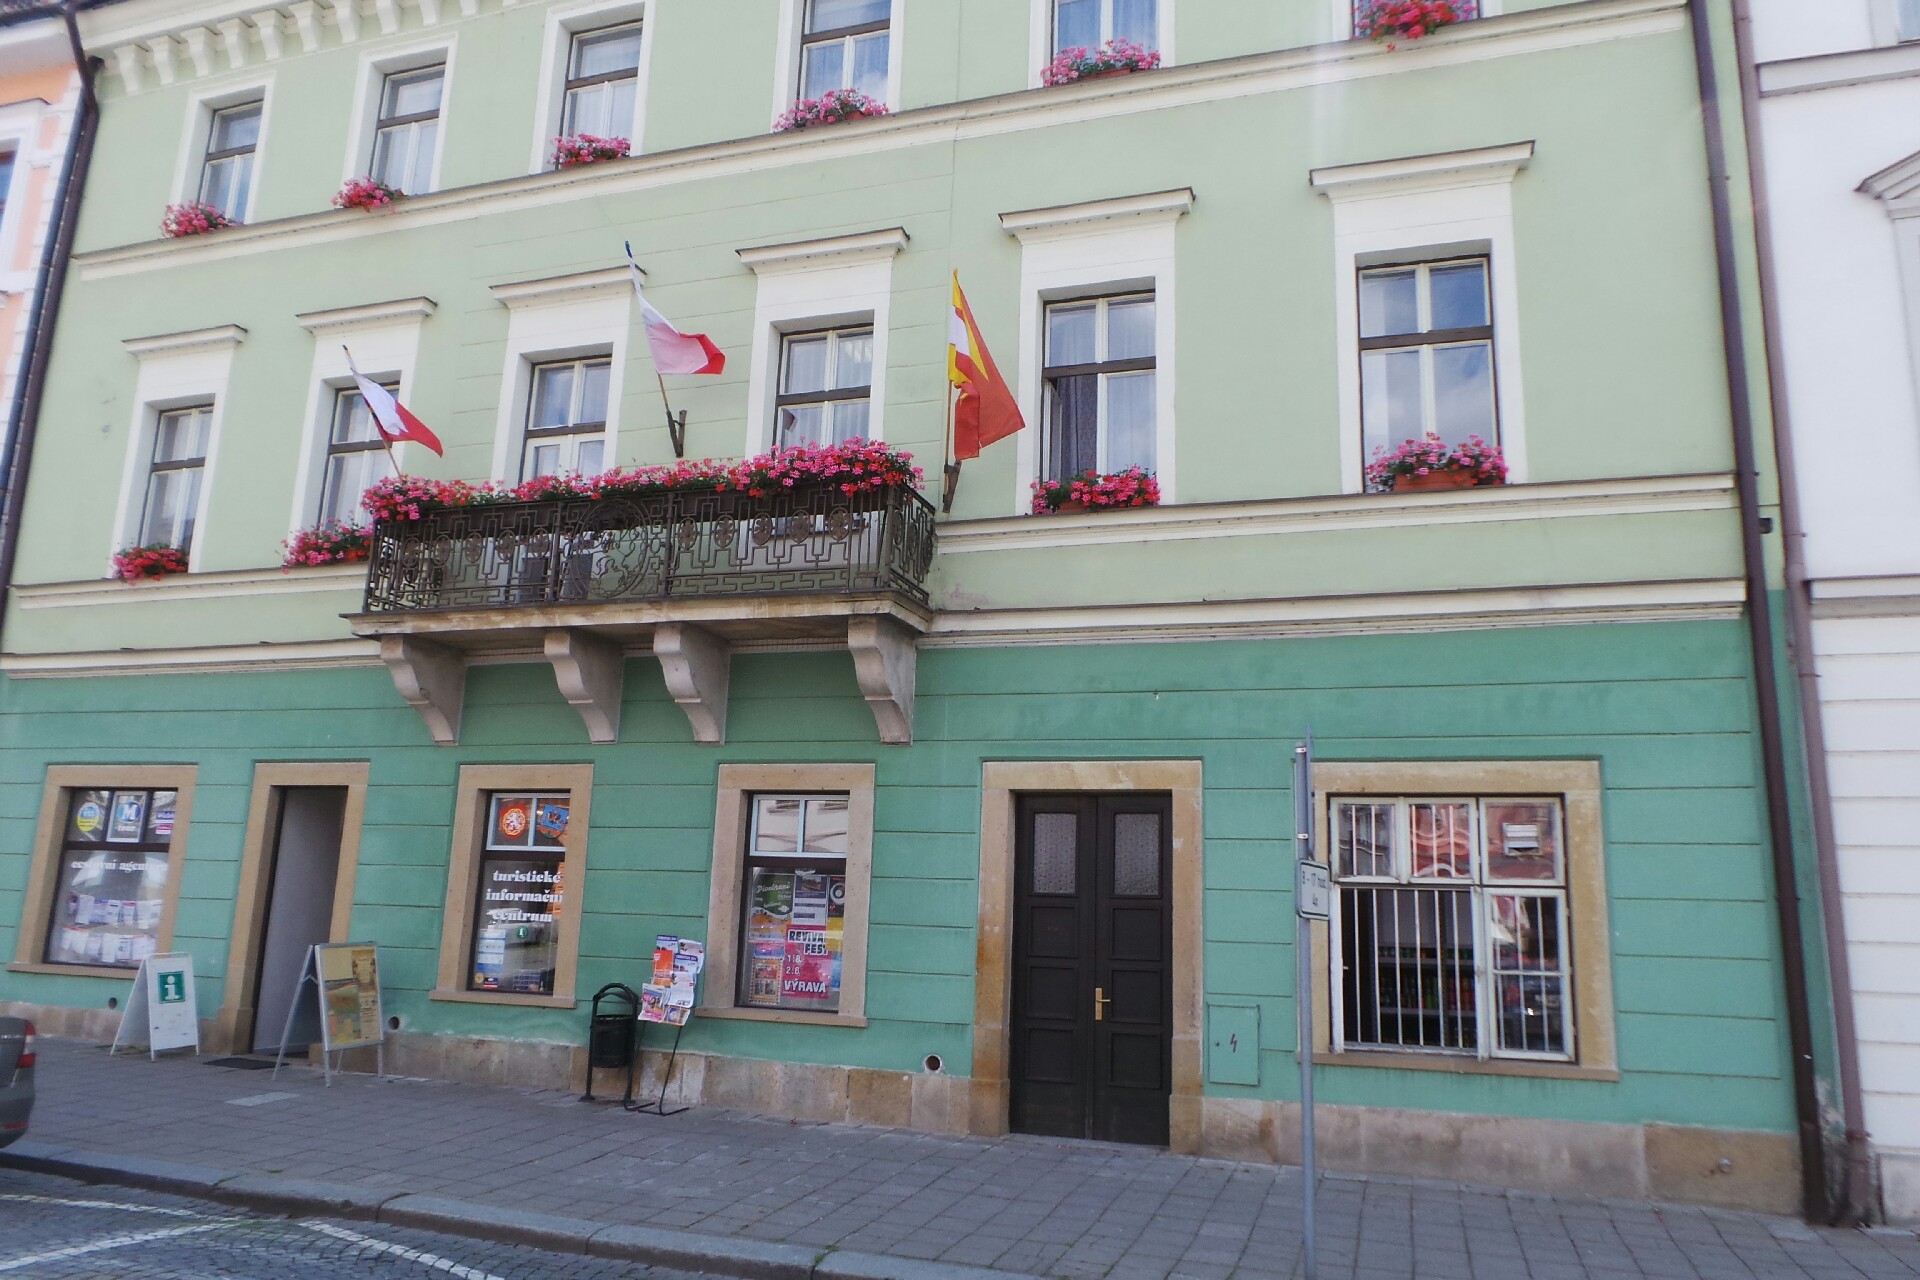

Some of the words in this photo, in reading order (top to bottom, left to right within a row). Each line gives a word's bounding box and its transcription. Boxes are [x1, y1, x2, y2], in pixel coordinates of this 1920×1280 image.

[493, 870, 563, 883] turistické
[486, 888, 563, 902] informační
[491, 910, 552, 922] centrum
[789, 930, 826, 942] REVIVA
[784, 979, 826, 993] VÝRAVA
